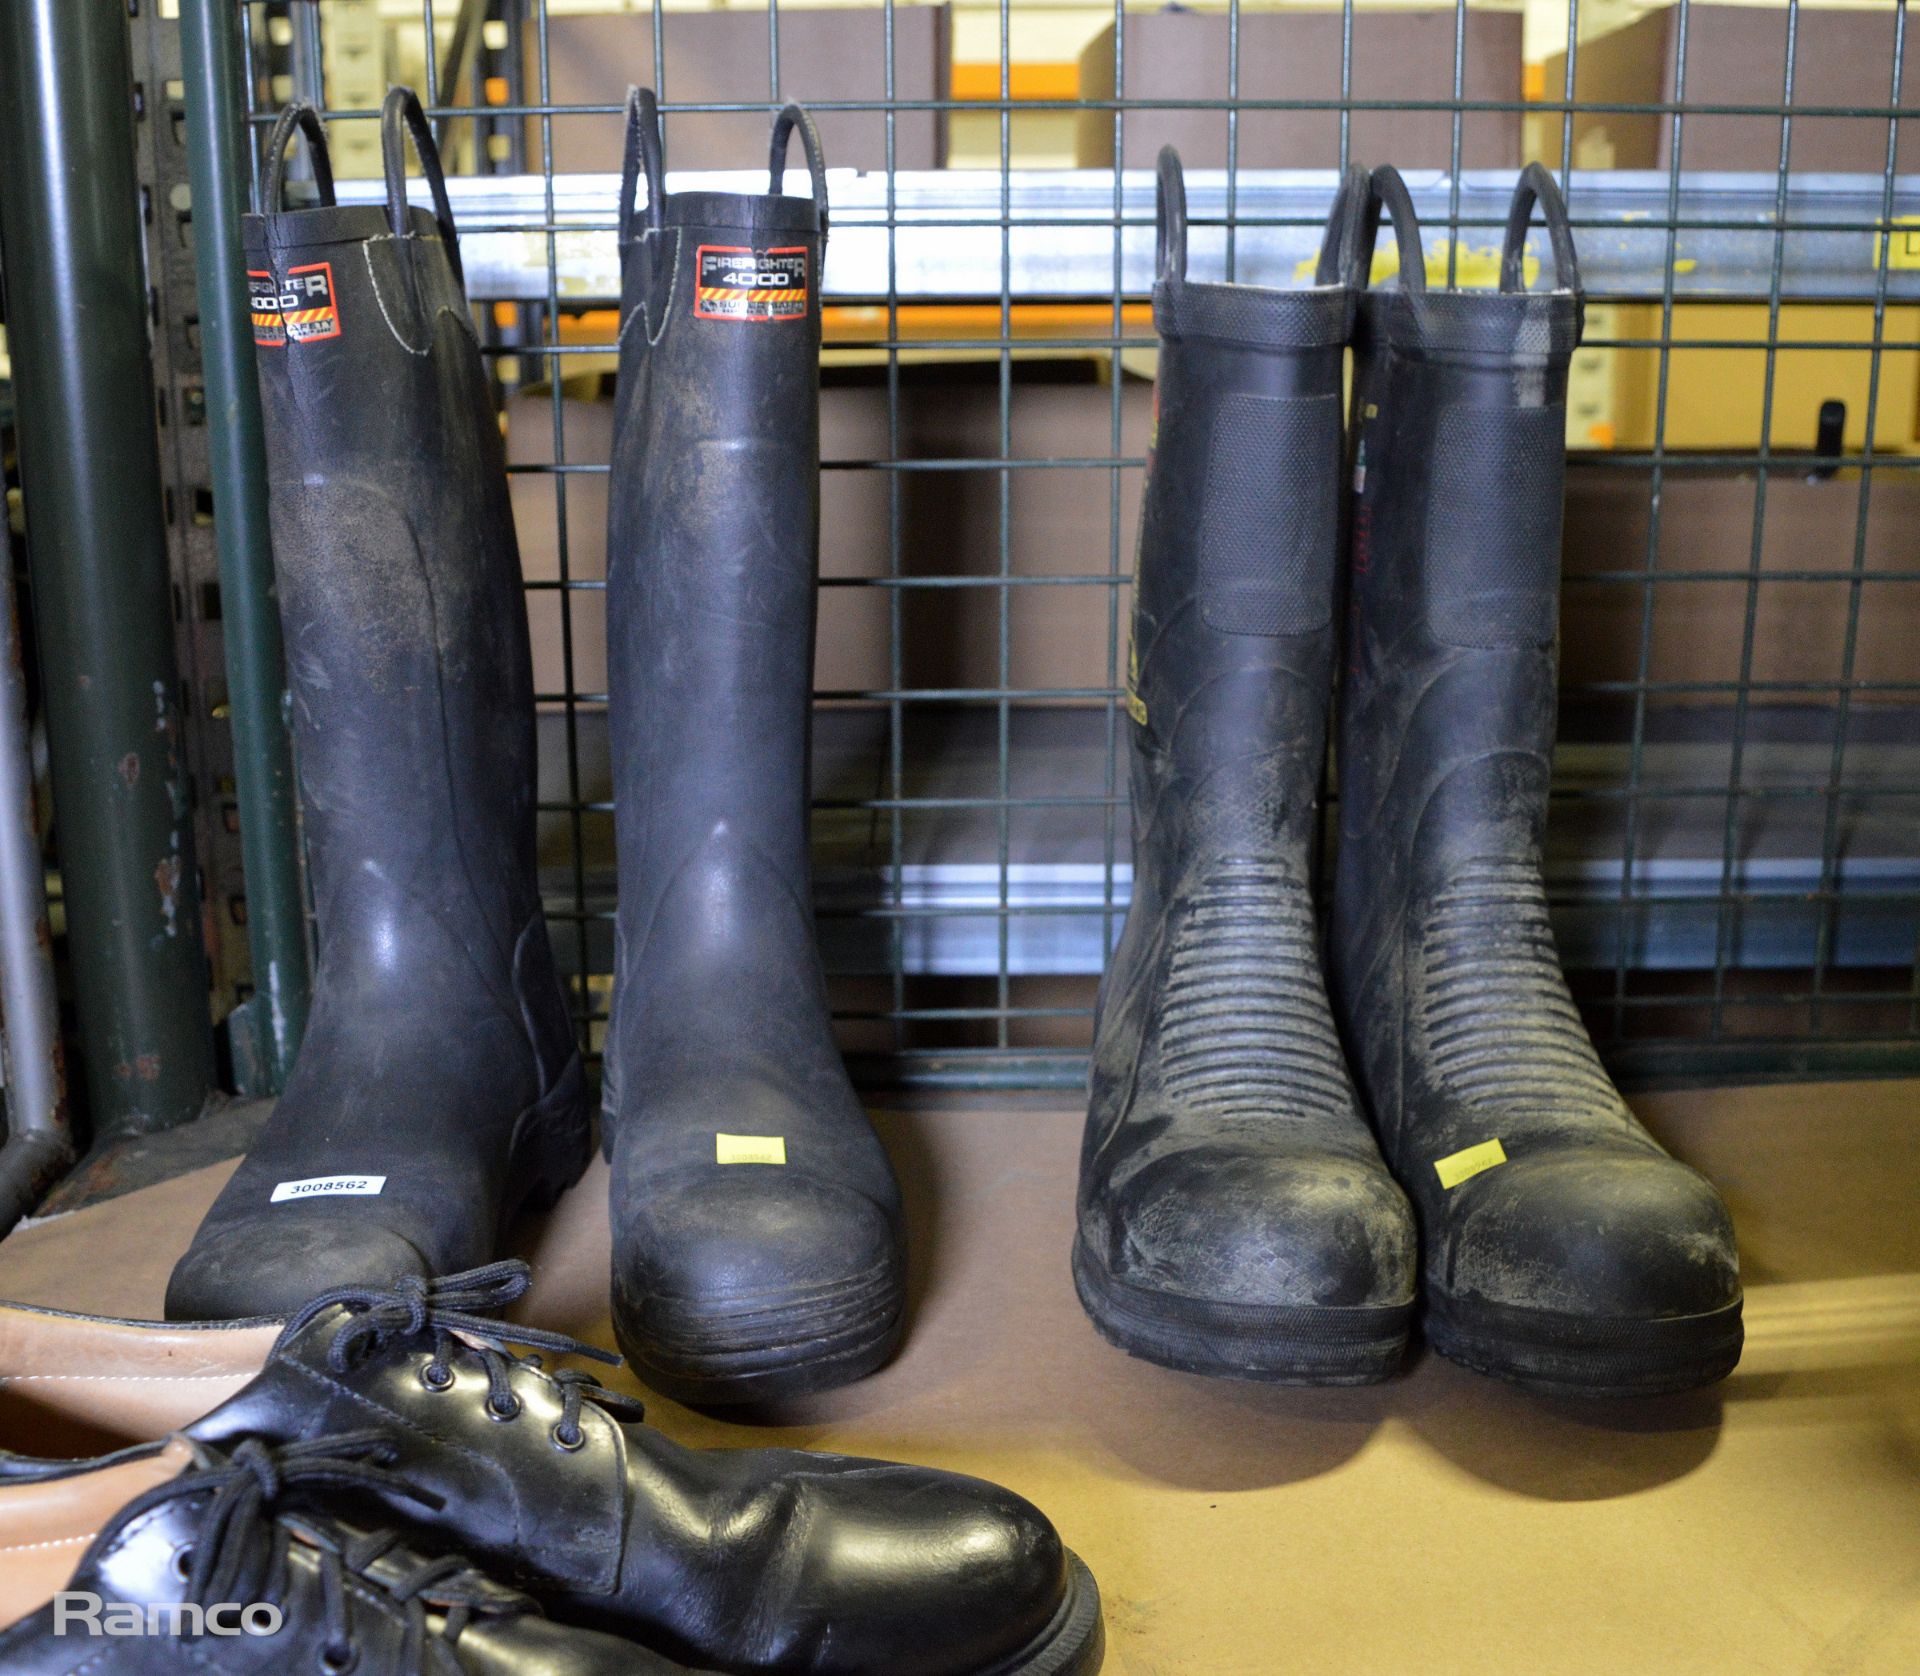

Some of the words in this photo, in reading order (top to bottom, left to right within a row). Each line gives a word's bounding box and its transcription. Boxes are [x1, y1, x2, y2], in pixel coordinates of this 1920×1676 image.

[702, 256, 805, 277] FIREFIGHTER
[722, 271, 789, 286] 4000
[290, 1180, 368, 1194] 3008562
